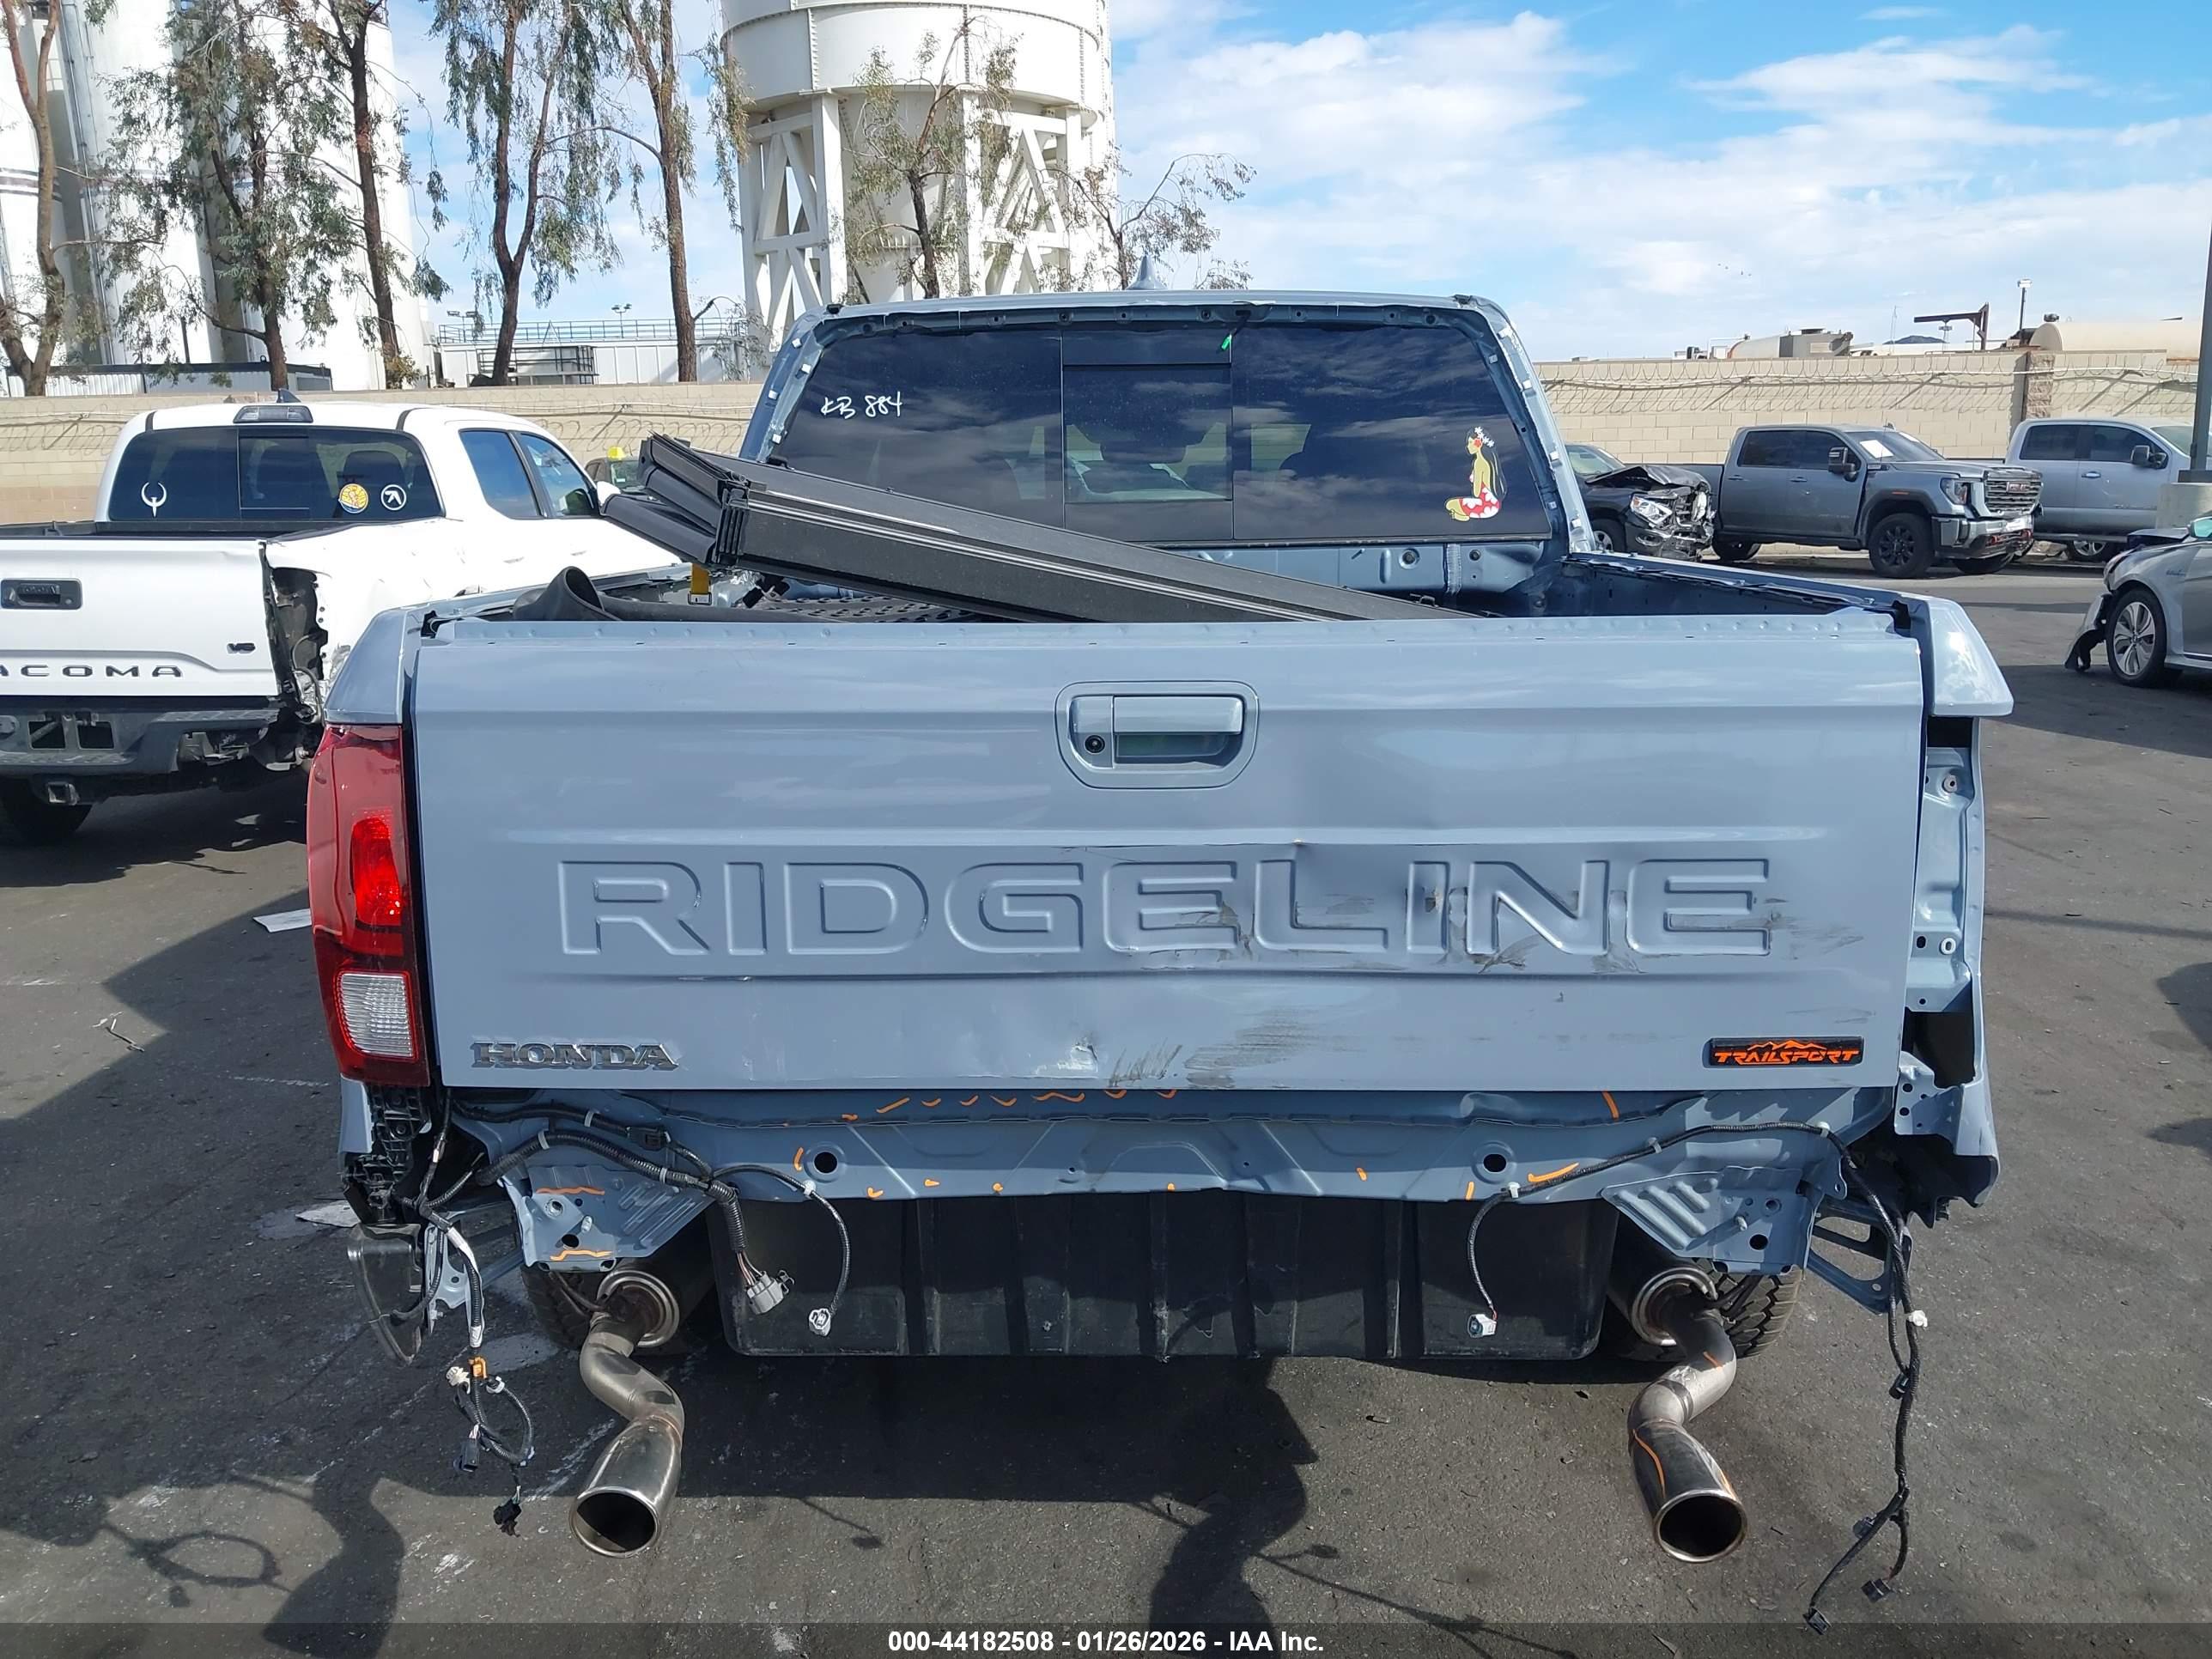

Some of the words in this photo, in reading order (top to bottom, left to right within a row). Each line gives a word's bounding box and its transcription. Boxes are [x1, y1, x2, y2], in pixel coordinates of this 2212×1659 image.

[865, 391, 902, 416] 884
[227, 642, 256, 653] V6
[0, 664, 183, 677] COMA
[557, 860, 1771, 957] RIDGELINE
[471, 1042, 679, 1071] HONDA
[1715, 1049, 1859, 1066] TRAILSPORT
